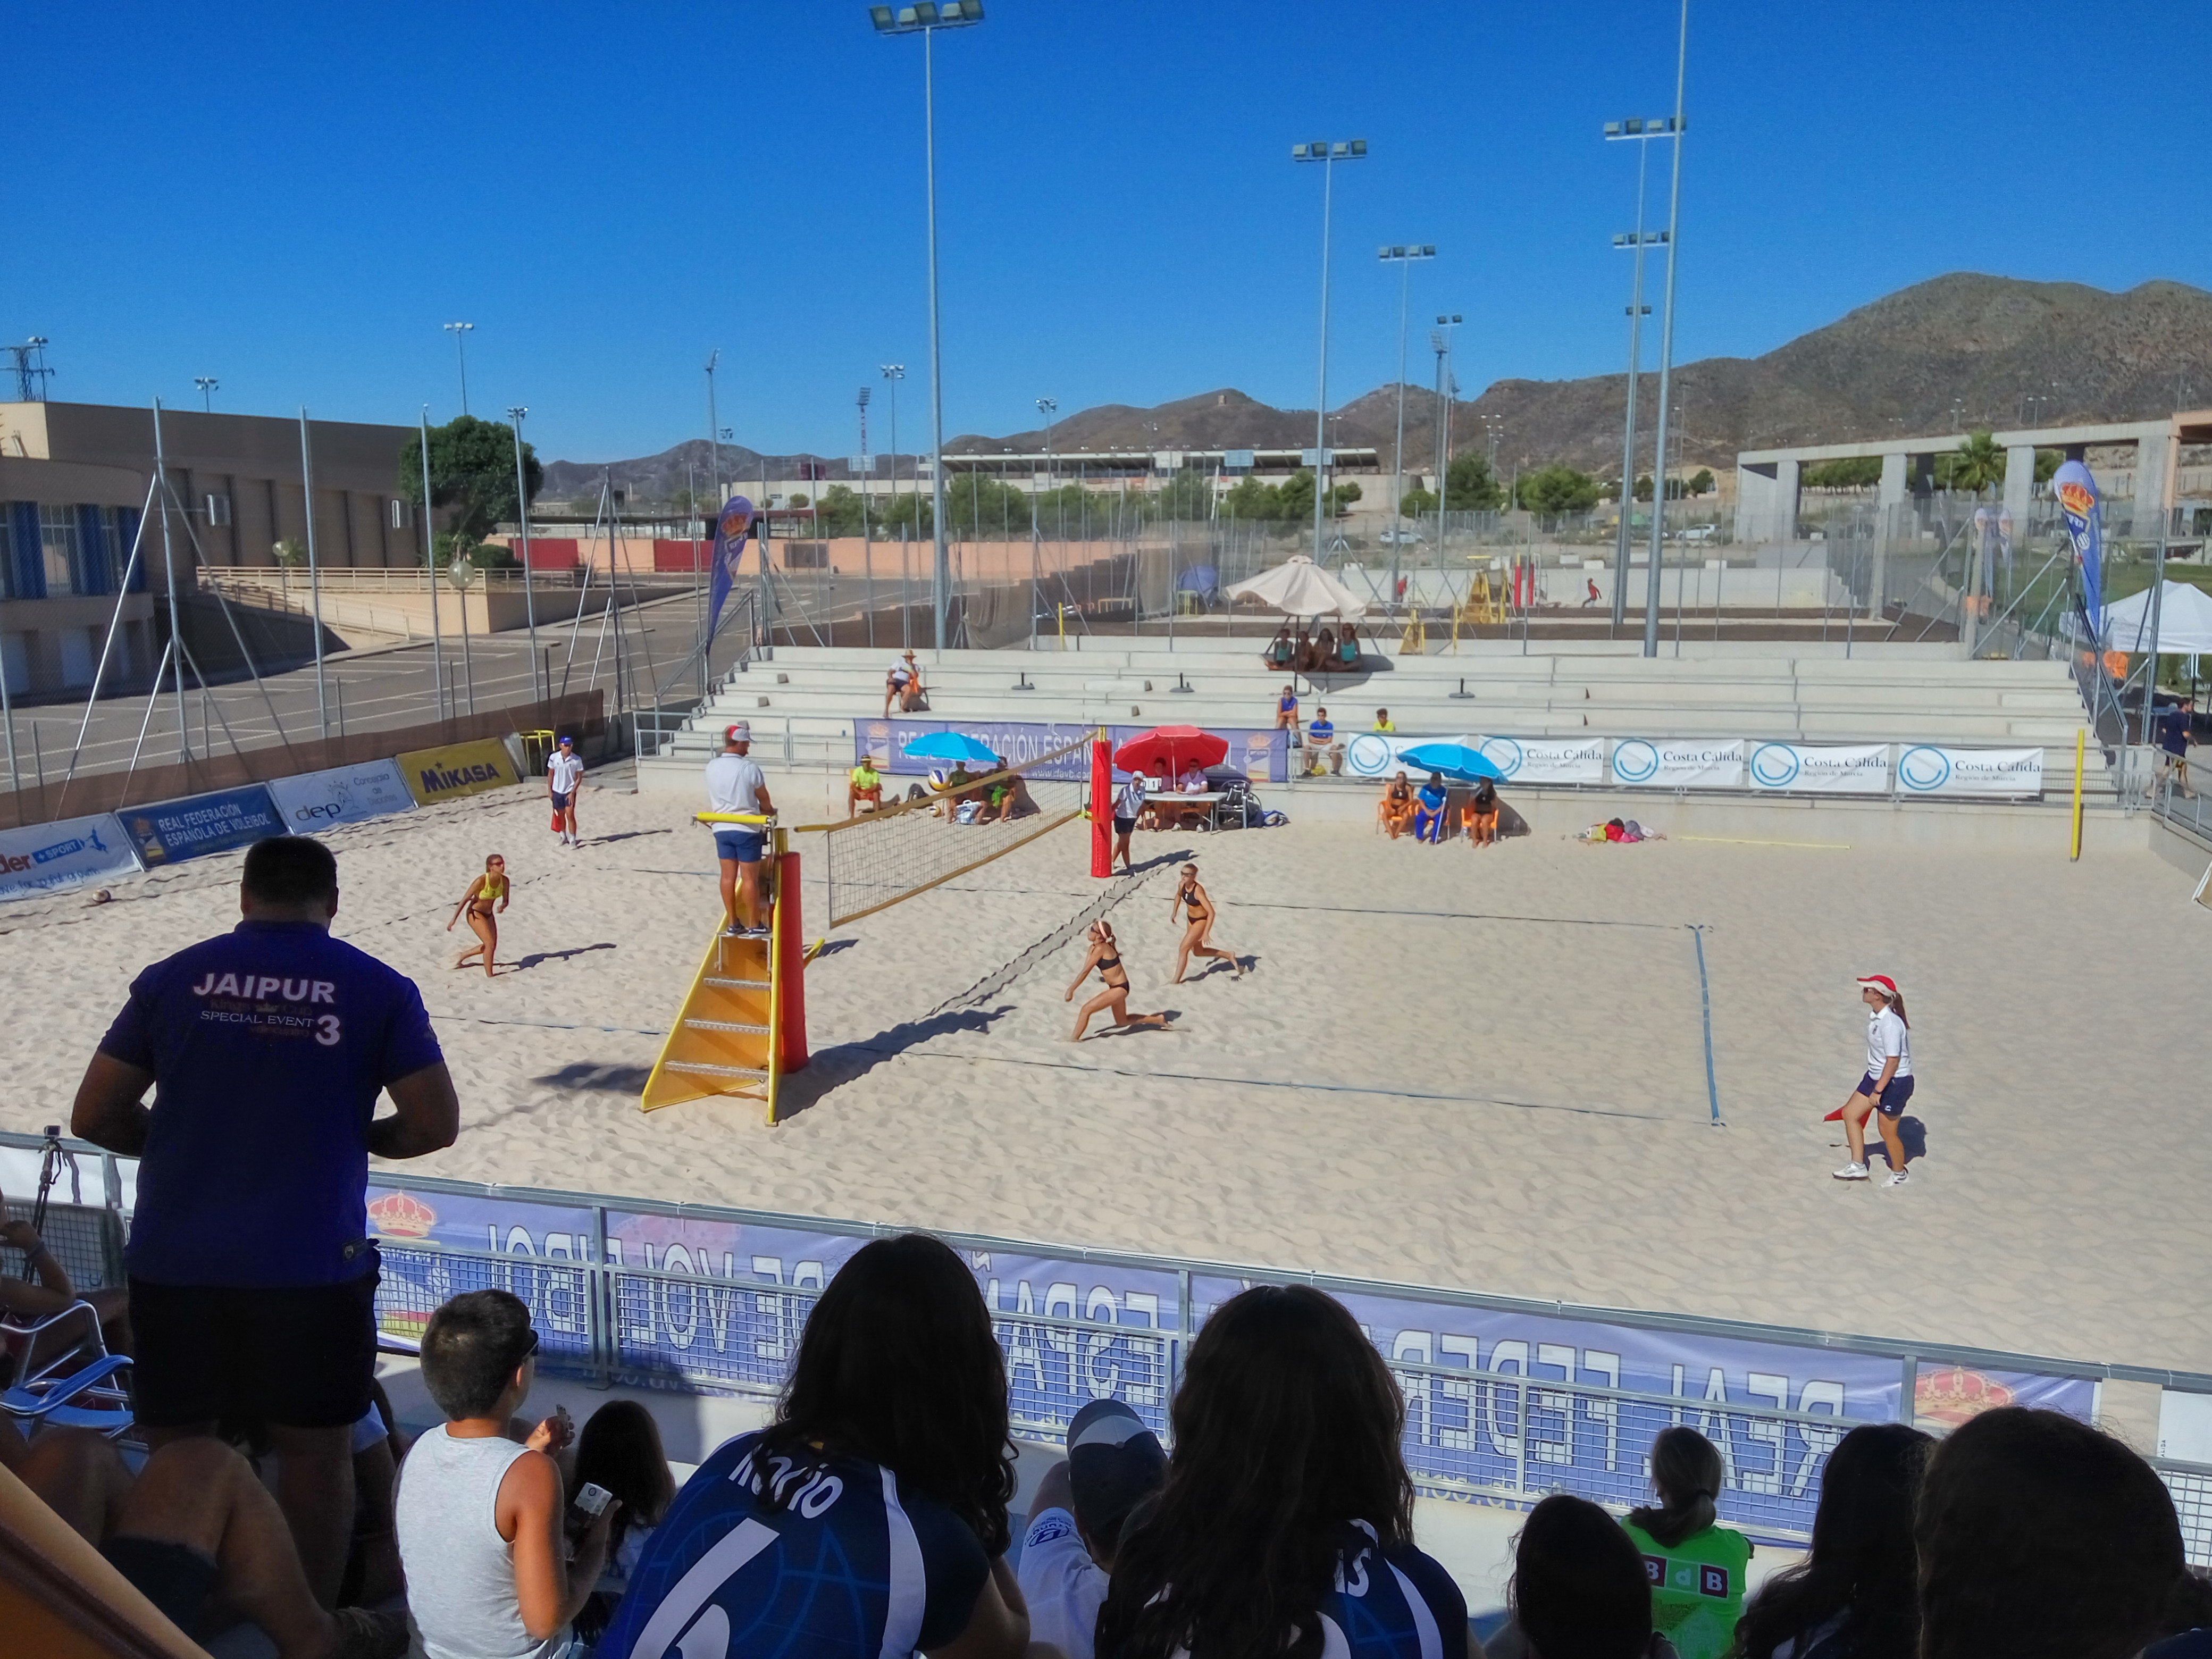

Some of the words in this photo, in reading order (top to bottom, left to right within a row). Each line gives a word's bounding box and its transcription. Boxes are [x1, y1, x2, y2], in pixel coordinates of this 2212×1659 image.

[1527, 749, 1559, 759] Costa
[1664, 751, 1697, 761] Costa
[1805, 757, 1840, 767] Costa
[1955, 760, 1993, 772] Costa
[420, 763, 500, 793] MIKASA
[158, 816, 185, 832] REAL
[184, 801, 242, 827] FEDERACIÓN
[296, 803, 341, 820] dep
[215, 822, 231, 834] DE
[229, 813, 271, 830] VOLEIBOL
[193, 973, 335, 1003] JAIPUR
[200, 1010, 263, 1024] SPECIAL
[267, 1016, 315, 1027] EVENT
[315, 1015, 340, 1046] 3
